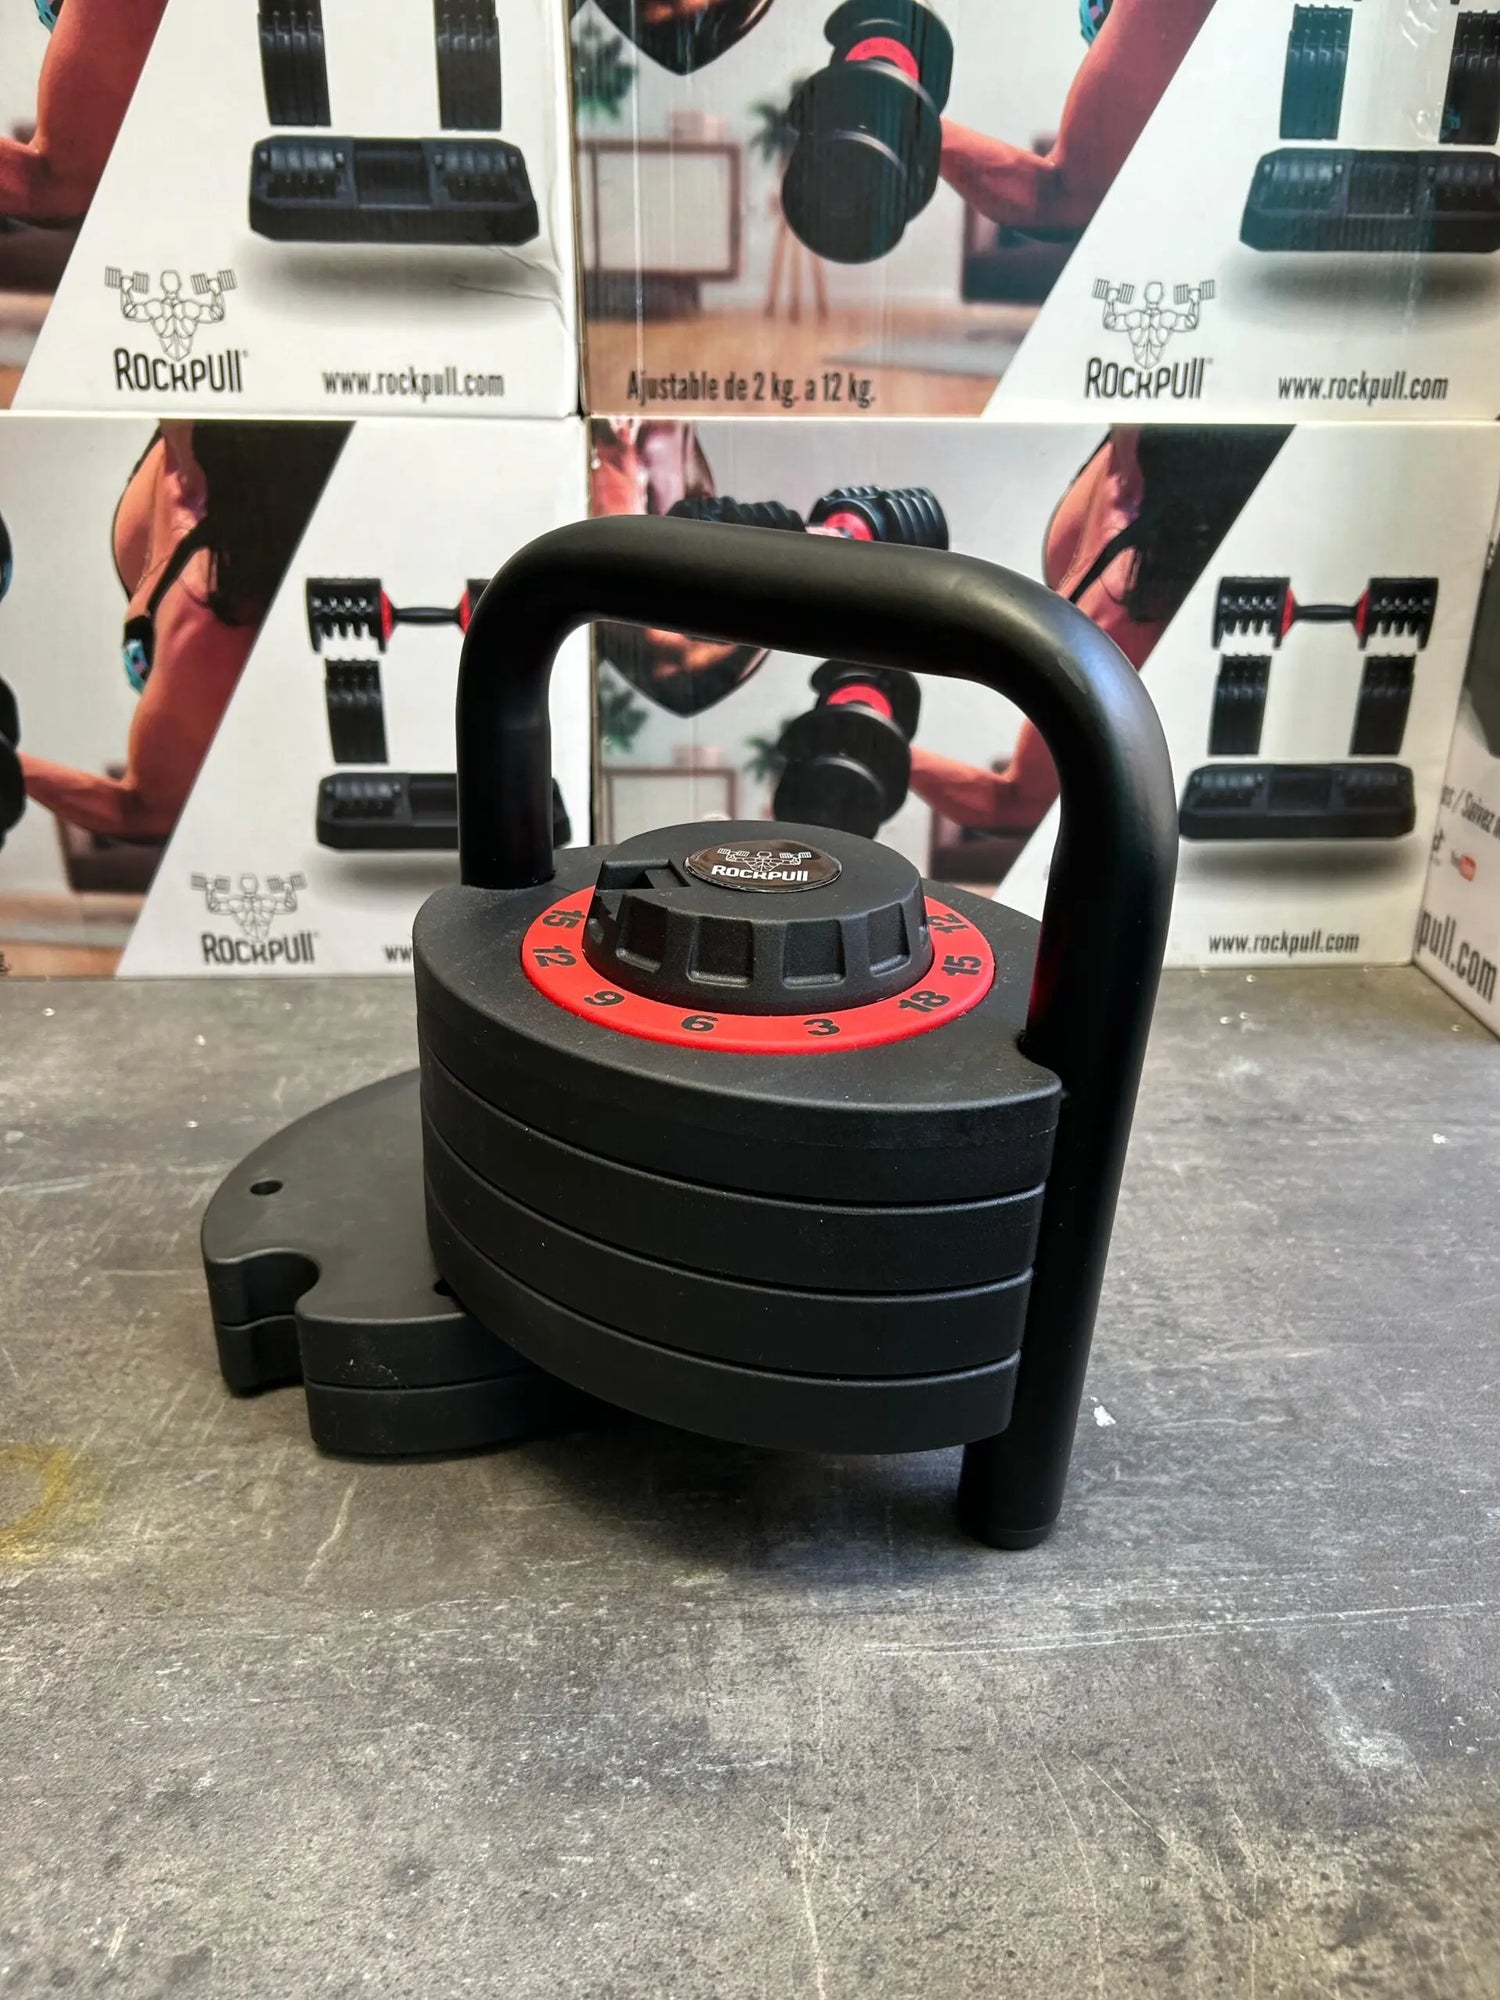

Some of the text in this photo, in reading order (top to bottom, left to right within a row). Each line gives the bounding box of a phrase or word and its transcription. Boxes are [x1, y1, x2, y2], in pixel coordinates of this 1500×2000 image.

[321, 366, 505, 402] www.rockpull.com
[626, 370, 718, 407] Ajustable
[724, 371, 748, 401] de
[753, 371, 766, 401] 2
[804, 378, 816, 401] a
[822, 372, 842, 401] 12
[1278, 370, 1449, 406] www.rockpull.com
[542, 909, 586, 929] 15
[927, 913, 969, 934] 12
[1208, 928, 1361, 959] www.rockpull.com
[532, 945, 577, 968] 12
[940, 954, 983, 977] 15
[897, 990, 951, 1013] 18
[680, 1014, 719, 1033] 6
[803, 1018, 841, 1036] 3
